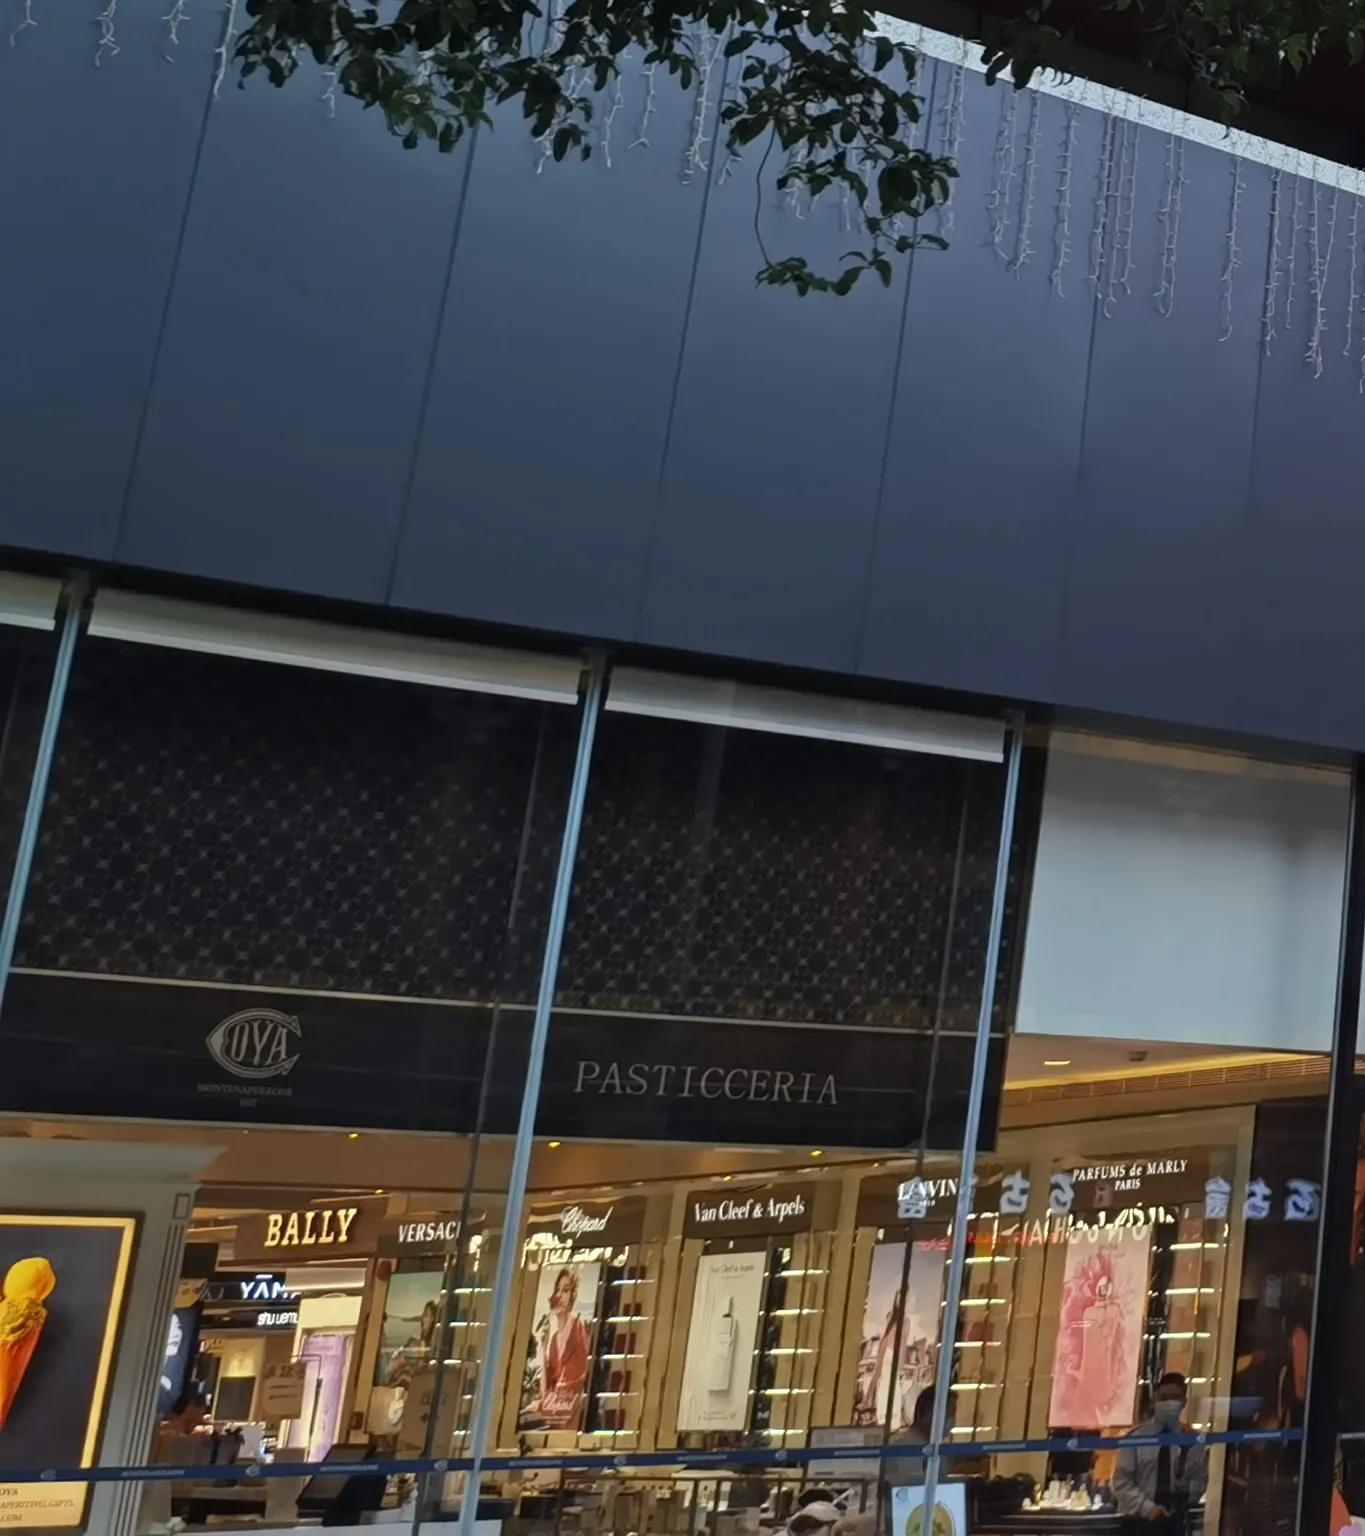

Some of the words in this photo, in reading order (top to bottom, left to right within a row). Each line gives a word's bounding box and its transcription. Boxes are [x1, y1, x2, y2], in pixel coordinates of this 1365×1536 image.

[573, 1060, 839, 1106] PASTICCERIA
[1072, 1162, 1125, 1182] PARFUMS
[1129, 1163, 1142, 1176] de
[1146, 1158, 1188, 1175] MARLY
[1114, 1177, 1141, 1192] PARIS
[898, 1178, 959, 1201] LANVIN
[560, 1206, 614, 1239] Chopard
[694, 1202, 717, 1222] Van
[718, 1199, 750, 1221] Cleef
[753, 1202, 762, 1218] &
[766, 1195, 805, 1224] Arpels
[264, 1208, 357, 1247] BALLY
